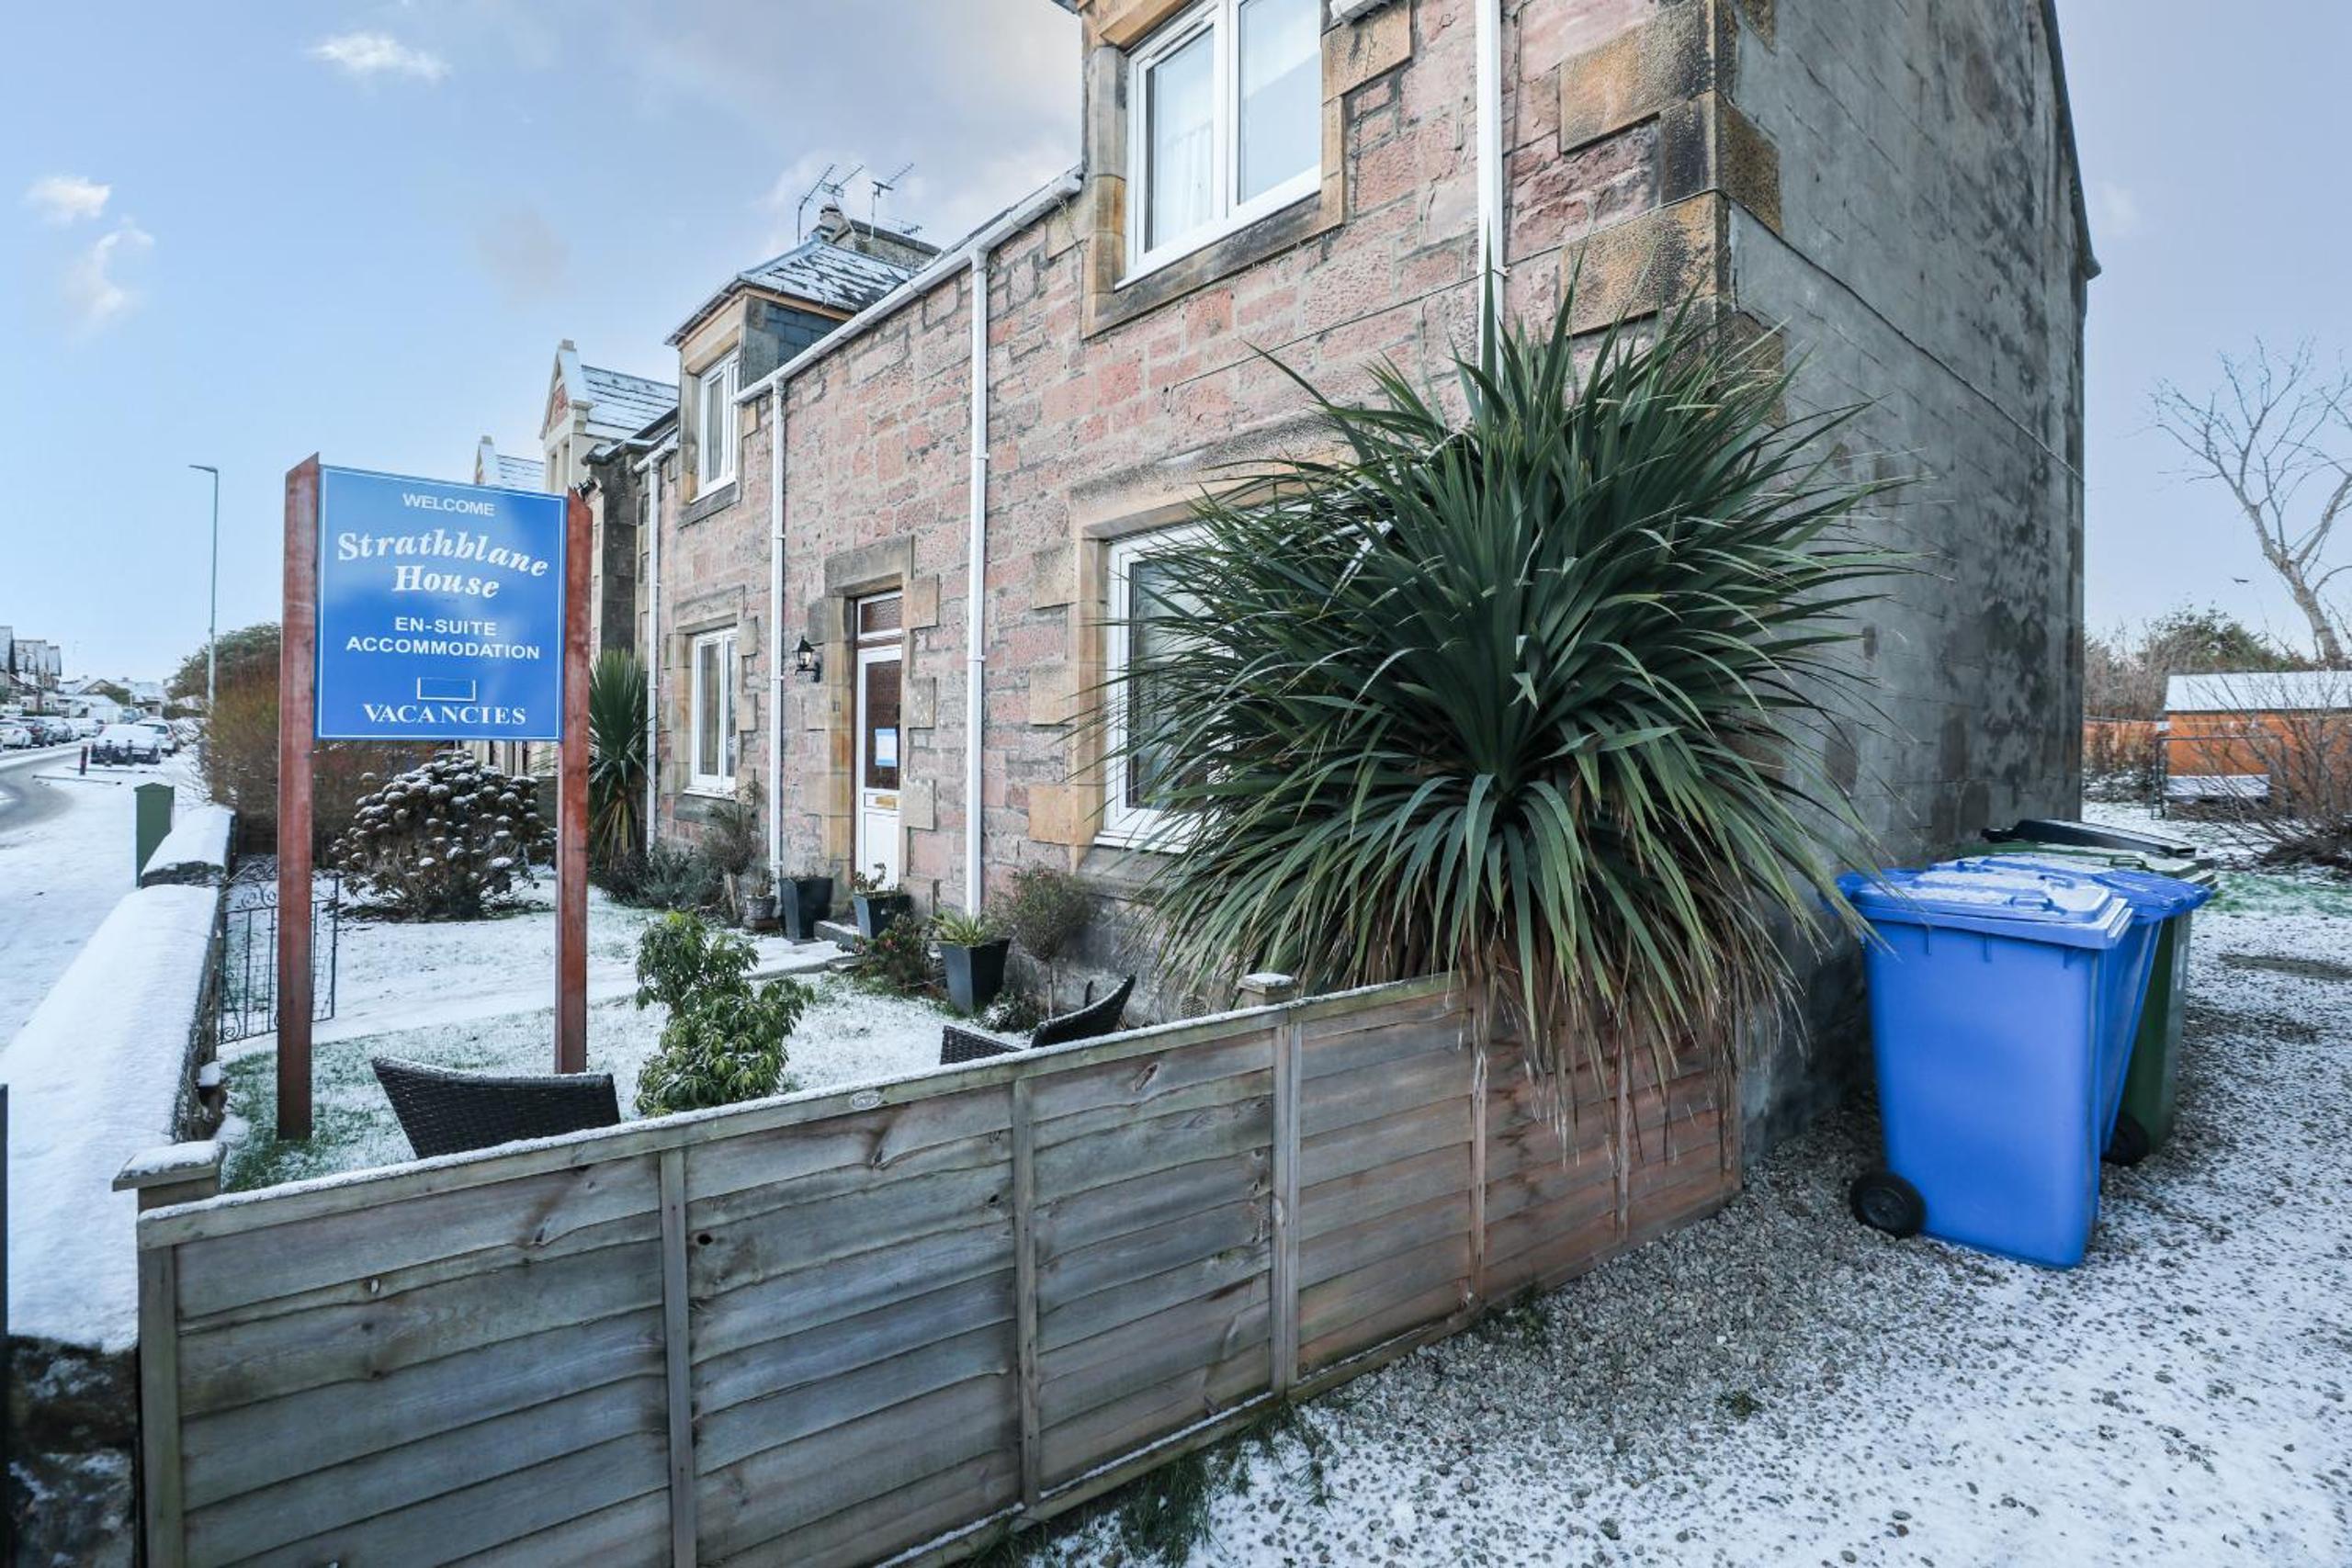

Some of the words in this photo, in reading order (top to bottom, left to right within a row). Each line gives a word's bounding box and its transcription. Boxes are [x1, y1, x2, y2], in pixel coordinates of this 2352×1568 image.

[402, 492, 495, 516] WELCOME
[337, 528, 549, 577] Strathblane
[391, 564, 500, 599] House
[394, 616, 497, 637] EN-SUITE
[346, 636, 540, 660] ACCOMMODATION
[364, 704, 526, 725] VACANCIES
